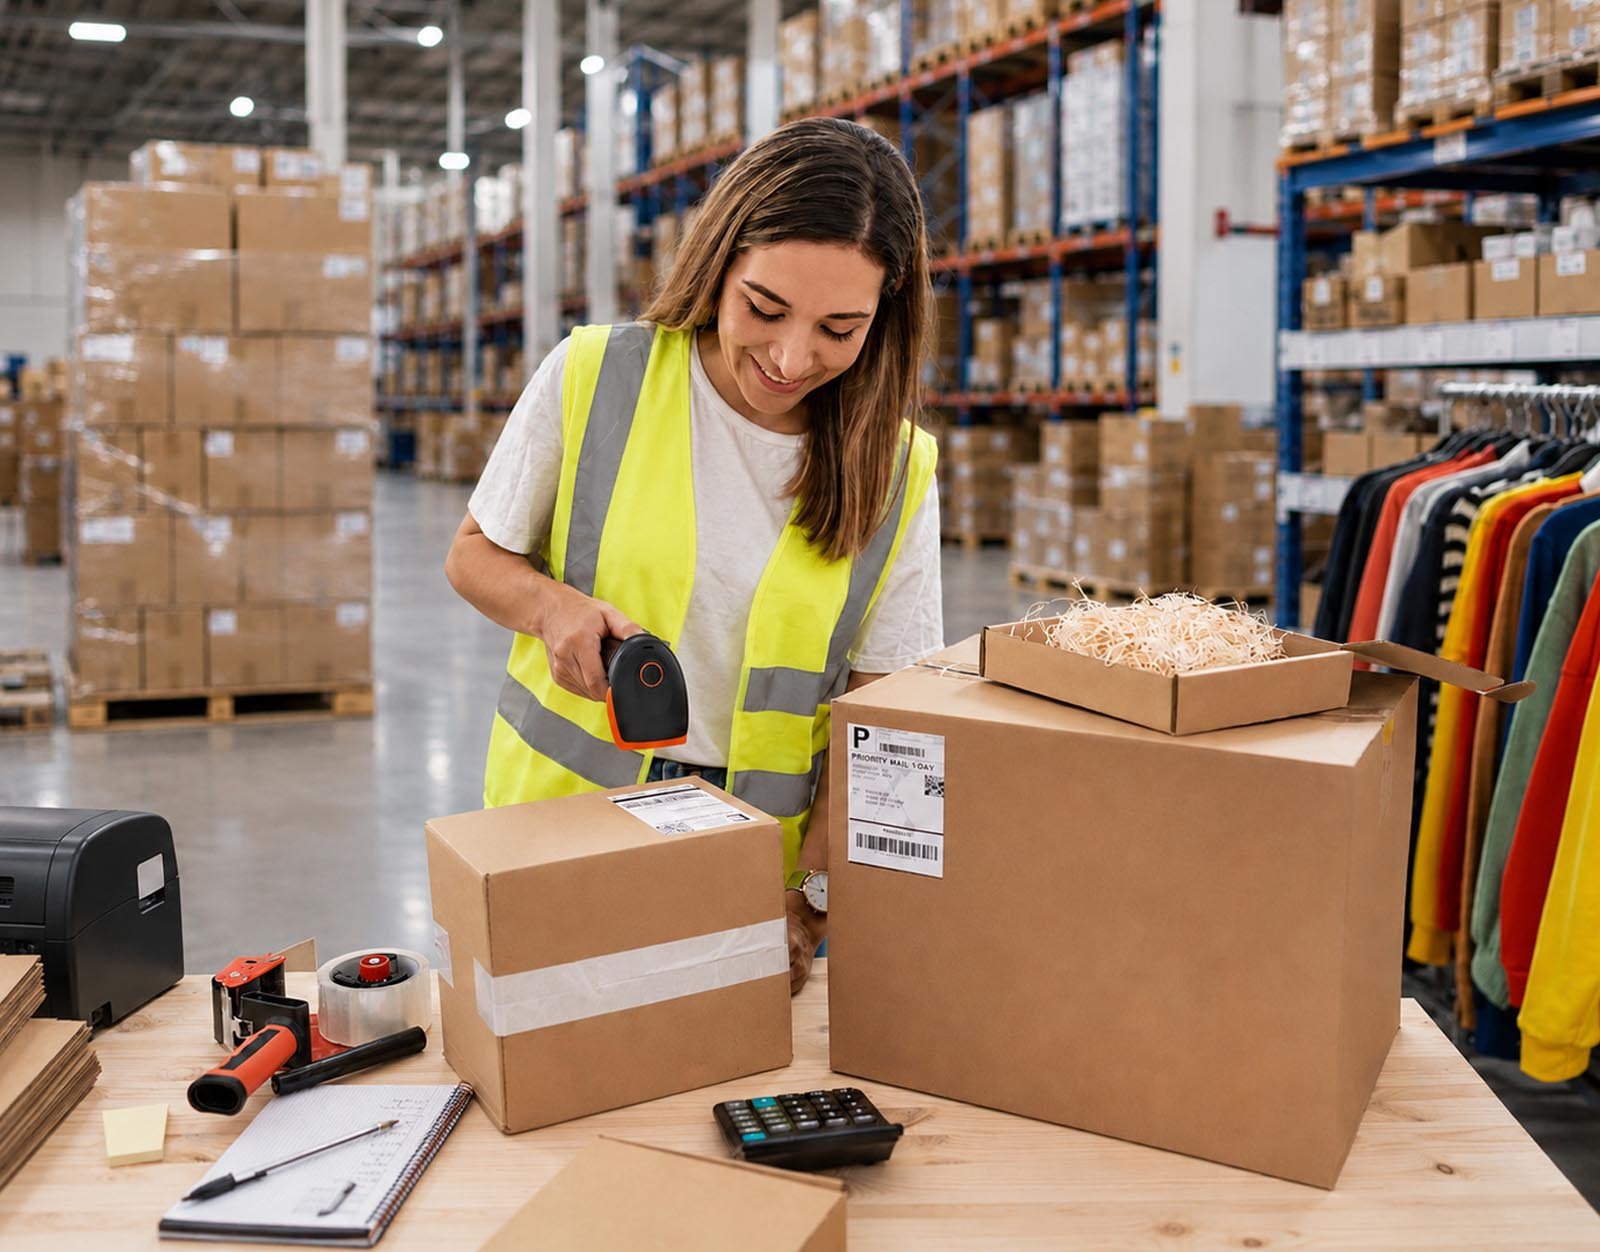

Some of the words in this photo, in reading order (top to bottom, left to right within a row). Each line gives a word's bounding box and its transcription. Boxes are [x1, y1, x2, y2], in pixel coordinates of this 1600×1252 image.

[853, 726, 870, 749] P
[851, 752, 888, 764] PRIORITY
[890, 759, 909, 769] MAIL
